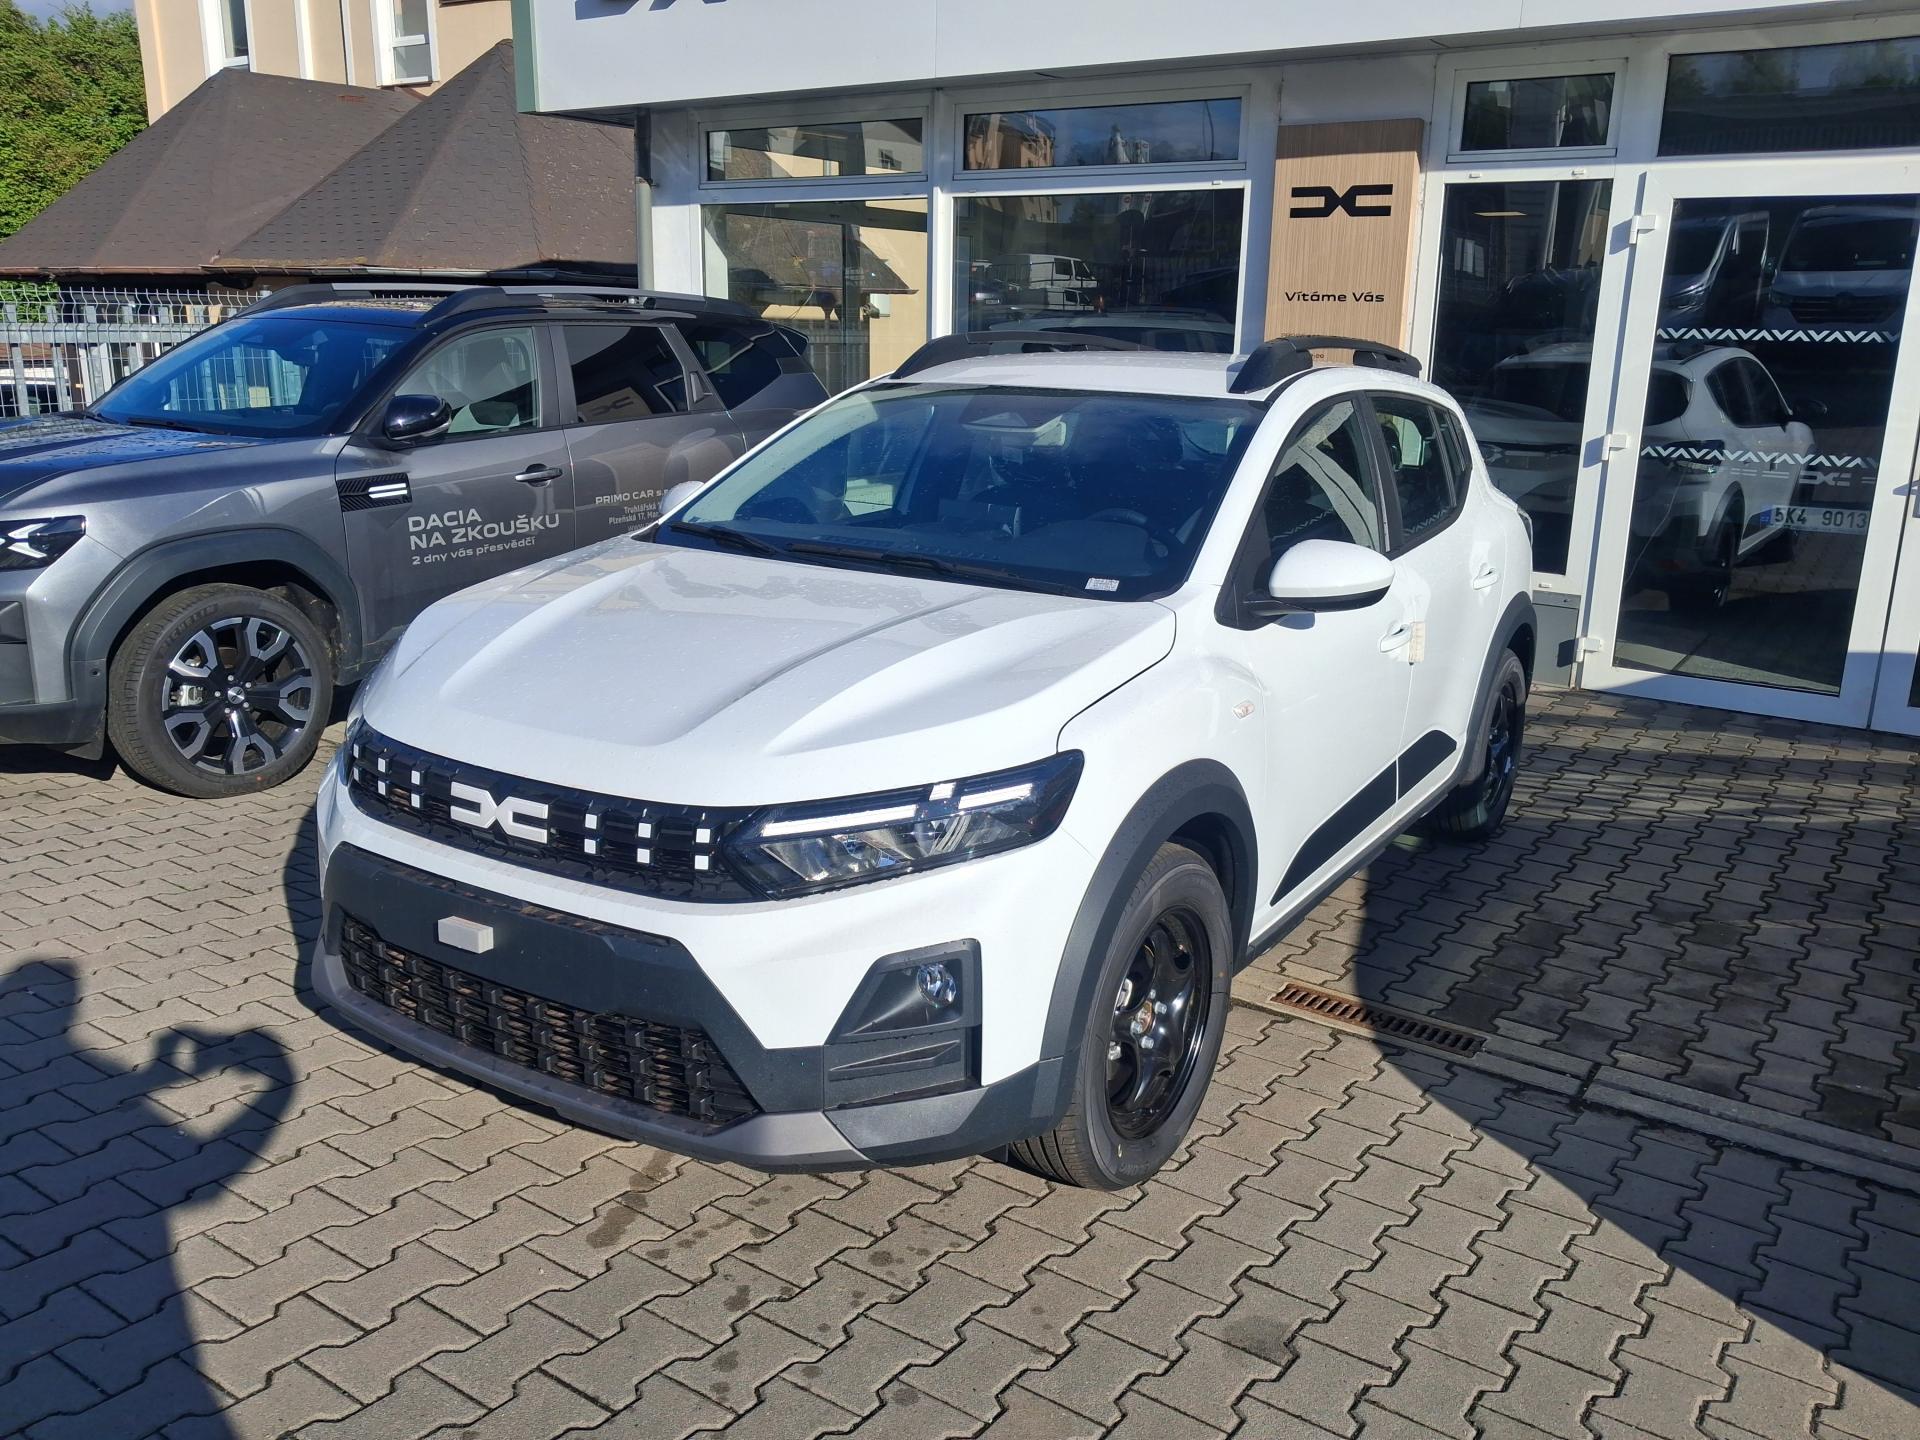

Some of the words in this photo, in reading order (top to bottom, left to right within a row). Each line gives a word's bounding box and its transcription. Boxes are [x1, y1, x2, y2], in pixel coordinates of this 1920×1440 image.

[1285, 290, 1347, 302] Vítáme
[1352, 291, 1385, 303] Vás
[595, 493, 631, 505] PRIMO
[632, 489, 654, 500] CAR
[407, 508, 483, 532] DACIA
[1775, 507, 1808, 525] 5K4
[1821, 510, 1868, 529] 9013
[409, 531, 447, 550] NA
[451, 513, 560, 544] ZKOUŠKU
[411, 555, 421, 565] 2
[423, 552, 448, 564] dny
[450, 547, 474, 558] vás
[476, 536, 537, 556] přesvědčí
